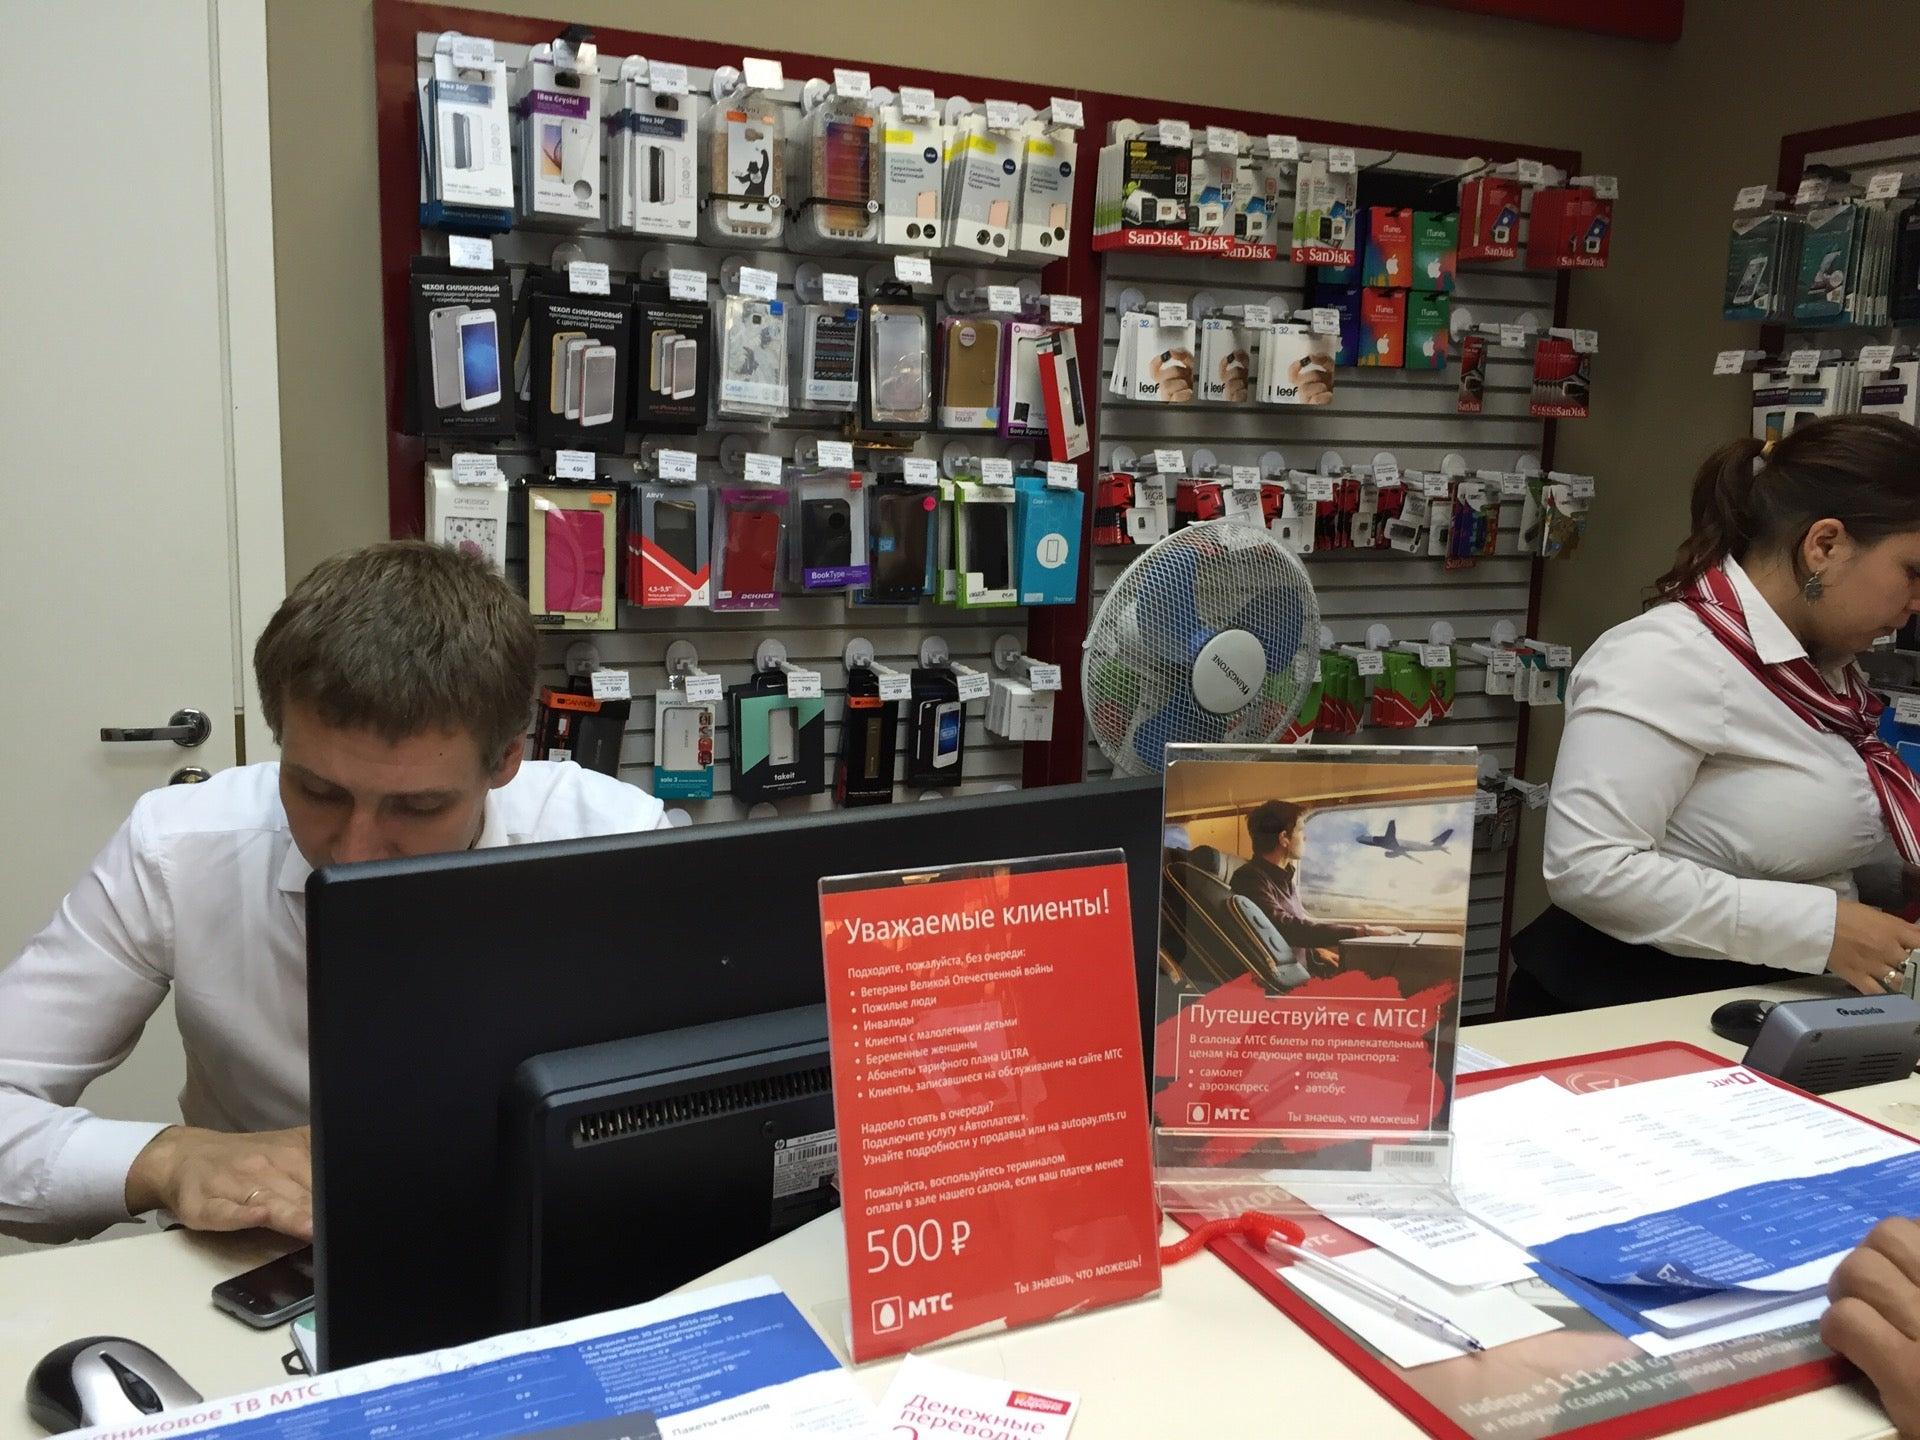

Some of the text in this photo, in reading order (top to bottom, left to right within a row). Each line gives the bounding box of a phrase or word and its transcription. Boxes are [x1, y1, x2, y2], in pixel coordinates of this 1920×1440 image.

[1383, 225, 1401, 233] iTunes
[1426, 229, 1446, 238] iTunes
[1128, 231, 1184, 246] SanDisk
[1309, 249, 1351, 264] SanDisk
[1484, 246, 1514, 257] SanDisk
[1576, 257, 1605, 268] SanDisk
[446, 284, 499, 292] СИЛИКОНОВЫЙ
[572, 309, 623, 319] СИЛИКОНОВЫЙ
[1375, 305, 1394, 314] iTunes
[1139, 382, 1160, 394] leef
[1210, 384, 1225, 394] leef
[1276, 385, 1298, 397] leef
[1556, 406, 1586, 417] SanDisk
[573, 466, 584, 474] 499
[811, 570, 845, 580] BookType
[844, 889, 1110, 944] Уважаемые клиенты!
[848, 948, 1026, 979] Подходите, пожалуйста, без очереди:
[861, 964, 1053, 997] Ветераны Великой Отечественной войны
[863, 996, 937, 1014] Пожилые люди
[1190, 1004, 1427, 1028] Путешествуйте с МТС!
[864, 1016, 914, 1032] Инвалиды
[865, 1017, 1017, 1048] Клиенты с малолетними детьми
[1190, 1034, 1424, 1049] В салонах МТС билеты по привлекательным
[866, 1041, 977, 1065] Беременные женщины
[1189, 1050, 1223, 1060] ценам
[1241, 1050, 1303, 1061] следующие
[1306, 1052, 1333, 1062] виды
[1336, 1052, 1399, 1064] транспорта:
[867, 1048, 1028, 1082] Абоненты тарифного плана ULTRA
[1200, 1068, 1242, 1077] самолет
[869, 1048, 1122, 1099] Клиенты, записавшиеся на обслуживание на сайте МТС
[1306, 1070, 1337, 1081] поезд
[1199, 1083, 1269, 1094] аэроэкспресс
[1306, 1084, 1345, 1095] автобус
[861, 1101, 993, 1135] Надоело стоять в очереди?
[1215, 1108, 1250, 1121] МТС
[1288, 1112, 1419, 1125] Ты знаешь, что можешь!
[862, 1114, 1029, 1151] Подключите услугу «Автоплатеж».
[863, 1110, 1126, 1165] Узнайте подробности у продавца или на autopay.mts.ru
[865, 1154, 1065, 1200] Пожалуйста, воспользуйтесь терминалом
[866, 1159, 1124, 1216] оплаты в зале нашего салона, если ваш платеж менее
[867, 1218, 942, 1274] 500
[1015, 1255, 1142, 1294] Ты знаешь, что можешь!
[908, 1292, 953, 1319] МТС
[231, 1398, 261, 1416] ТВ
[269, 1383, 323, 1408] МТС
[1460, 1392, 1533, 1418] Набери
[671, 1403, 770, 1436] Пакеты каналов
[904, 1394, 1045, 1434] Денежные
